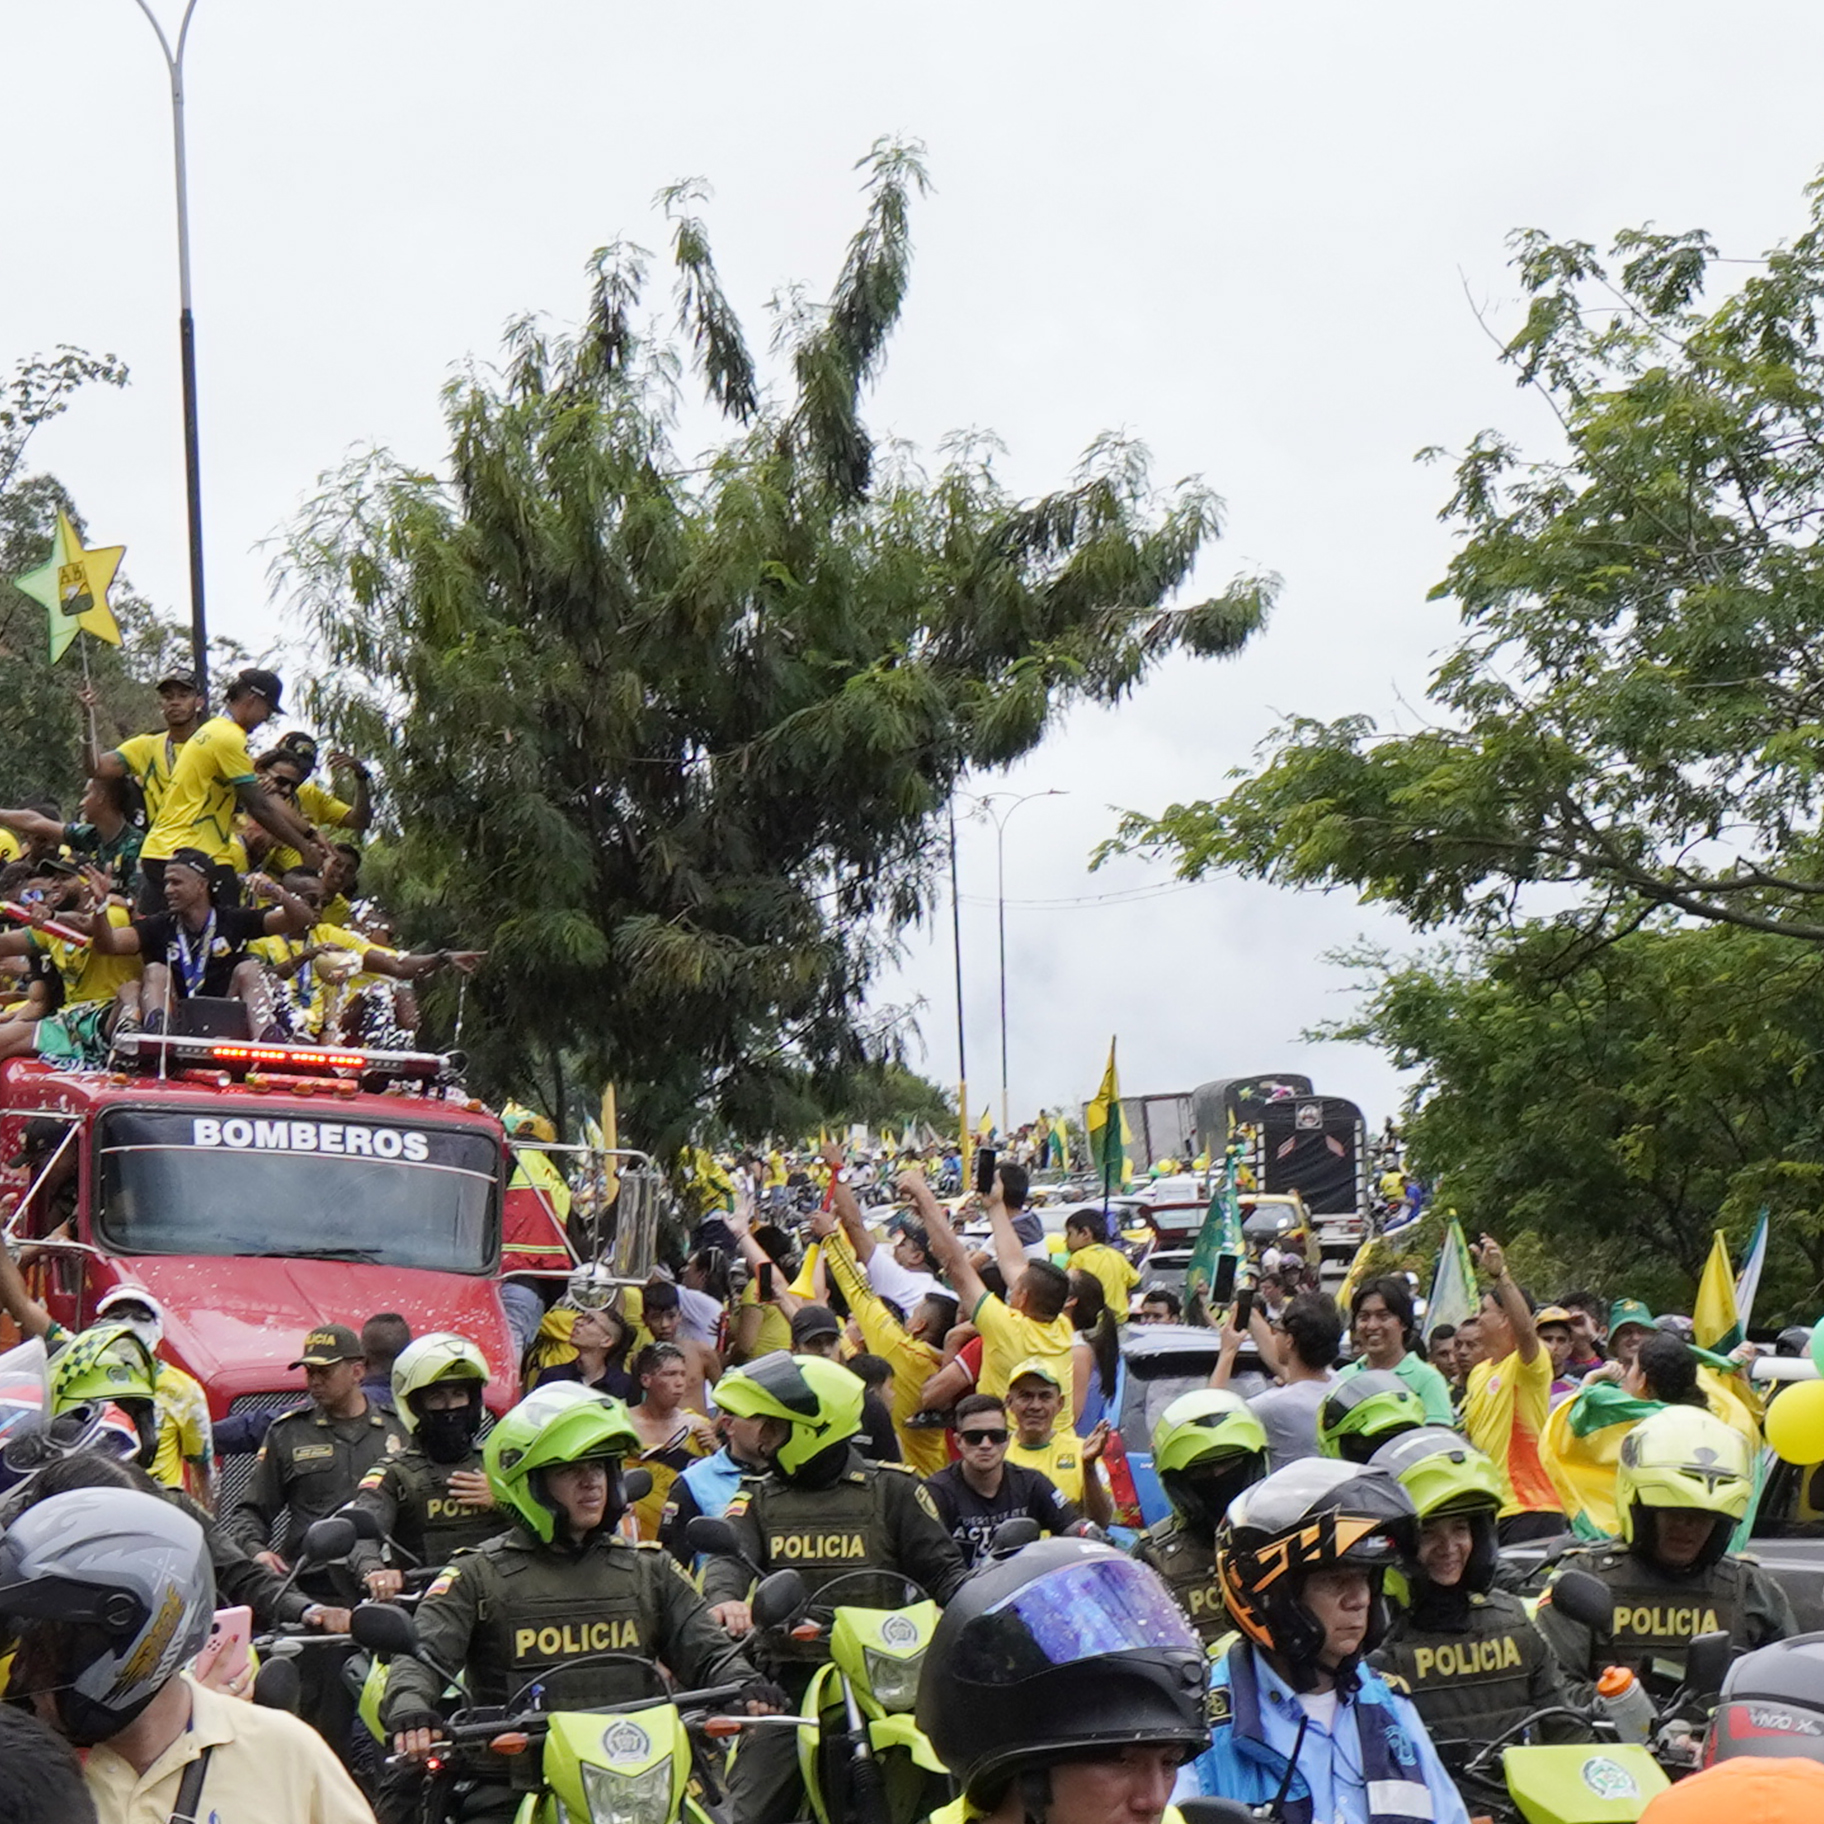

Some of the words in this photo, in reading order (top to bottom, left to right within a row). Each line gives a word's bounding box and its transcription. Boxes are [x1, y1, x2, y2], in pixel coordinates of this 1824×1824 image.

[192, 1117, 430, 1162] BOMBEROS
[769, 1534, 866, 1560] POLICIA
[515, 1619, 640, 1658] POLICIA
[1612, 1605, 1720, 1637] POLICIA
[1414, 1635, 1523, 1679] POLICIA
